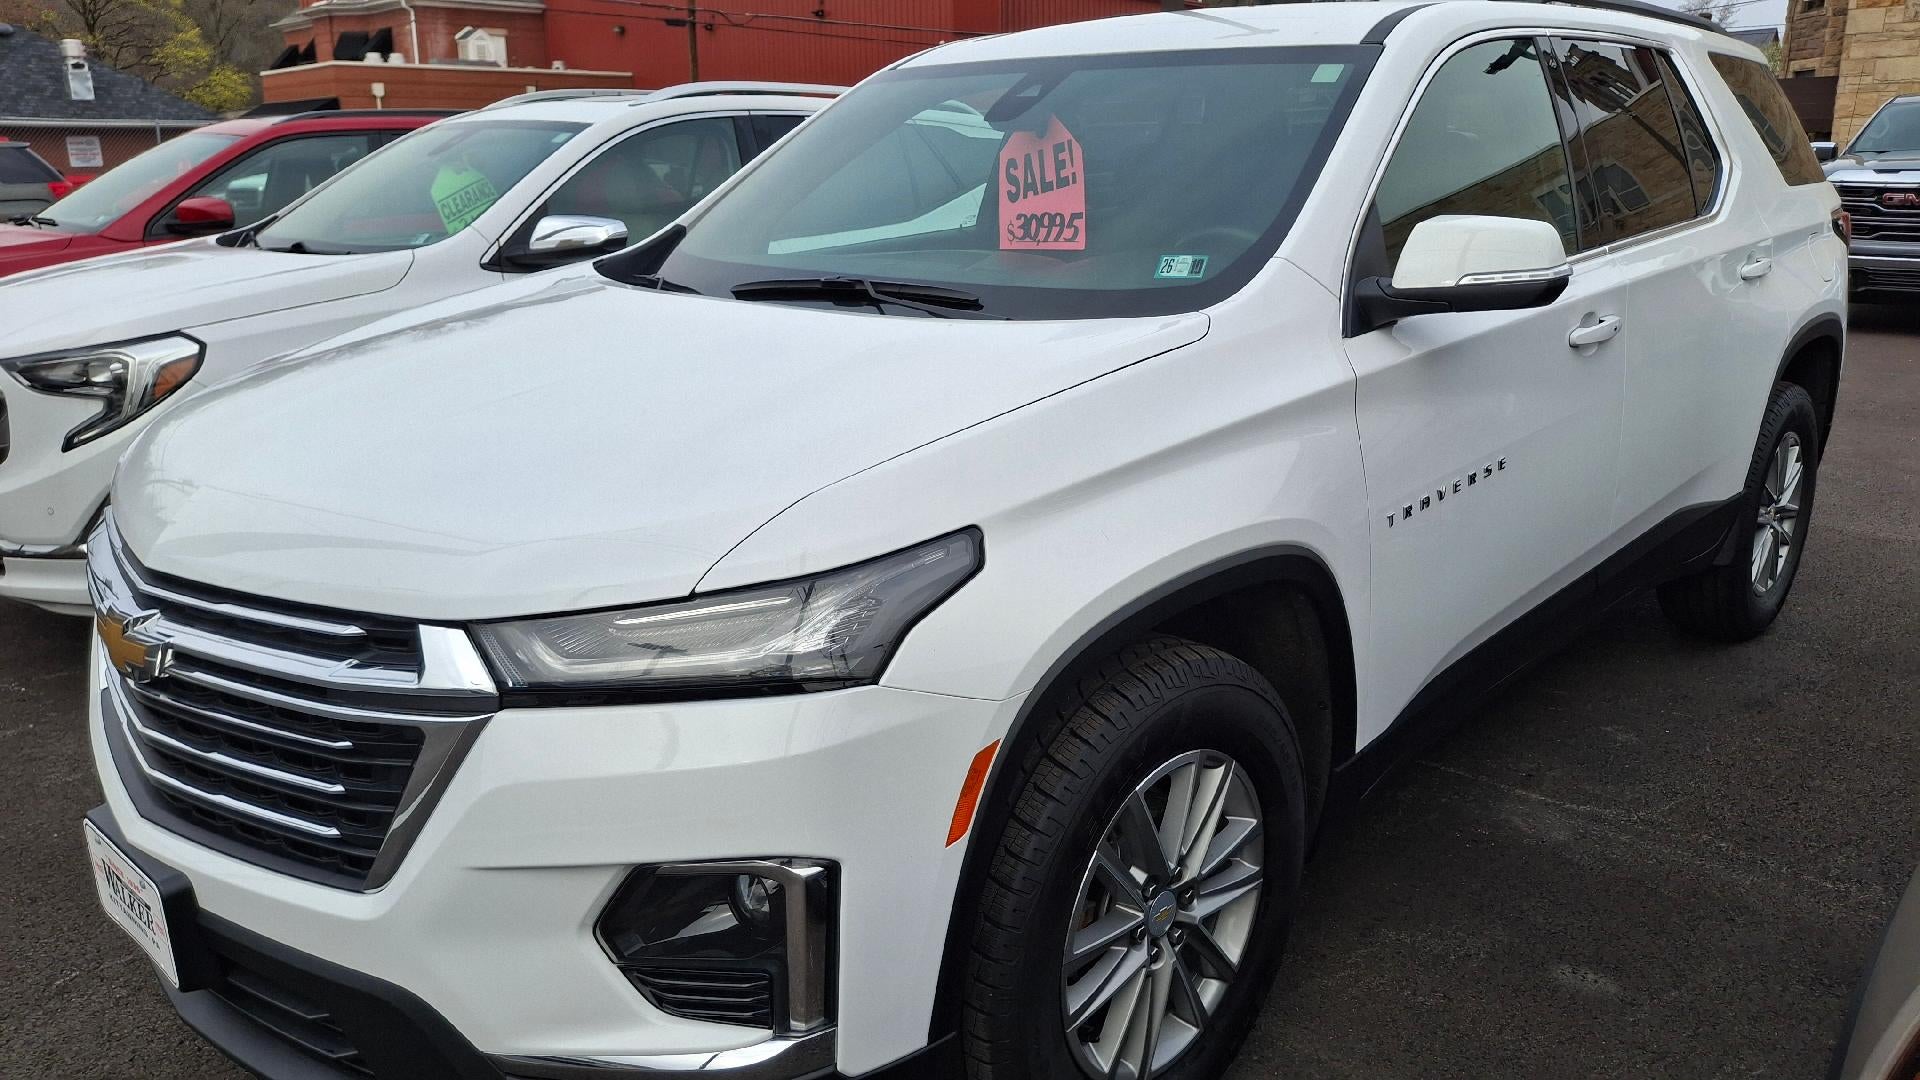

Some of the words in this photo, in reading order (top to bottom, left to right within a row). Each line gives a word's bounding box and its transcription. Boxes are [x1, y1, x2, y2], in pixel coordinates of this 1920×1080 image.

[1005, 139, 1077, 203] SALE!
[1160, 258, 1175, 274] 26
[1386, 457, 1507, 528] TRAVERSE
[101, 858, 157, 936] WALKER
